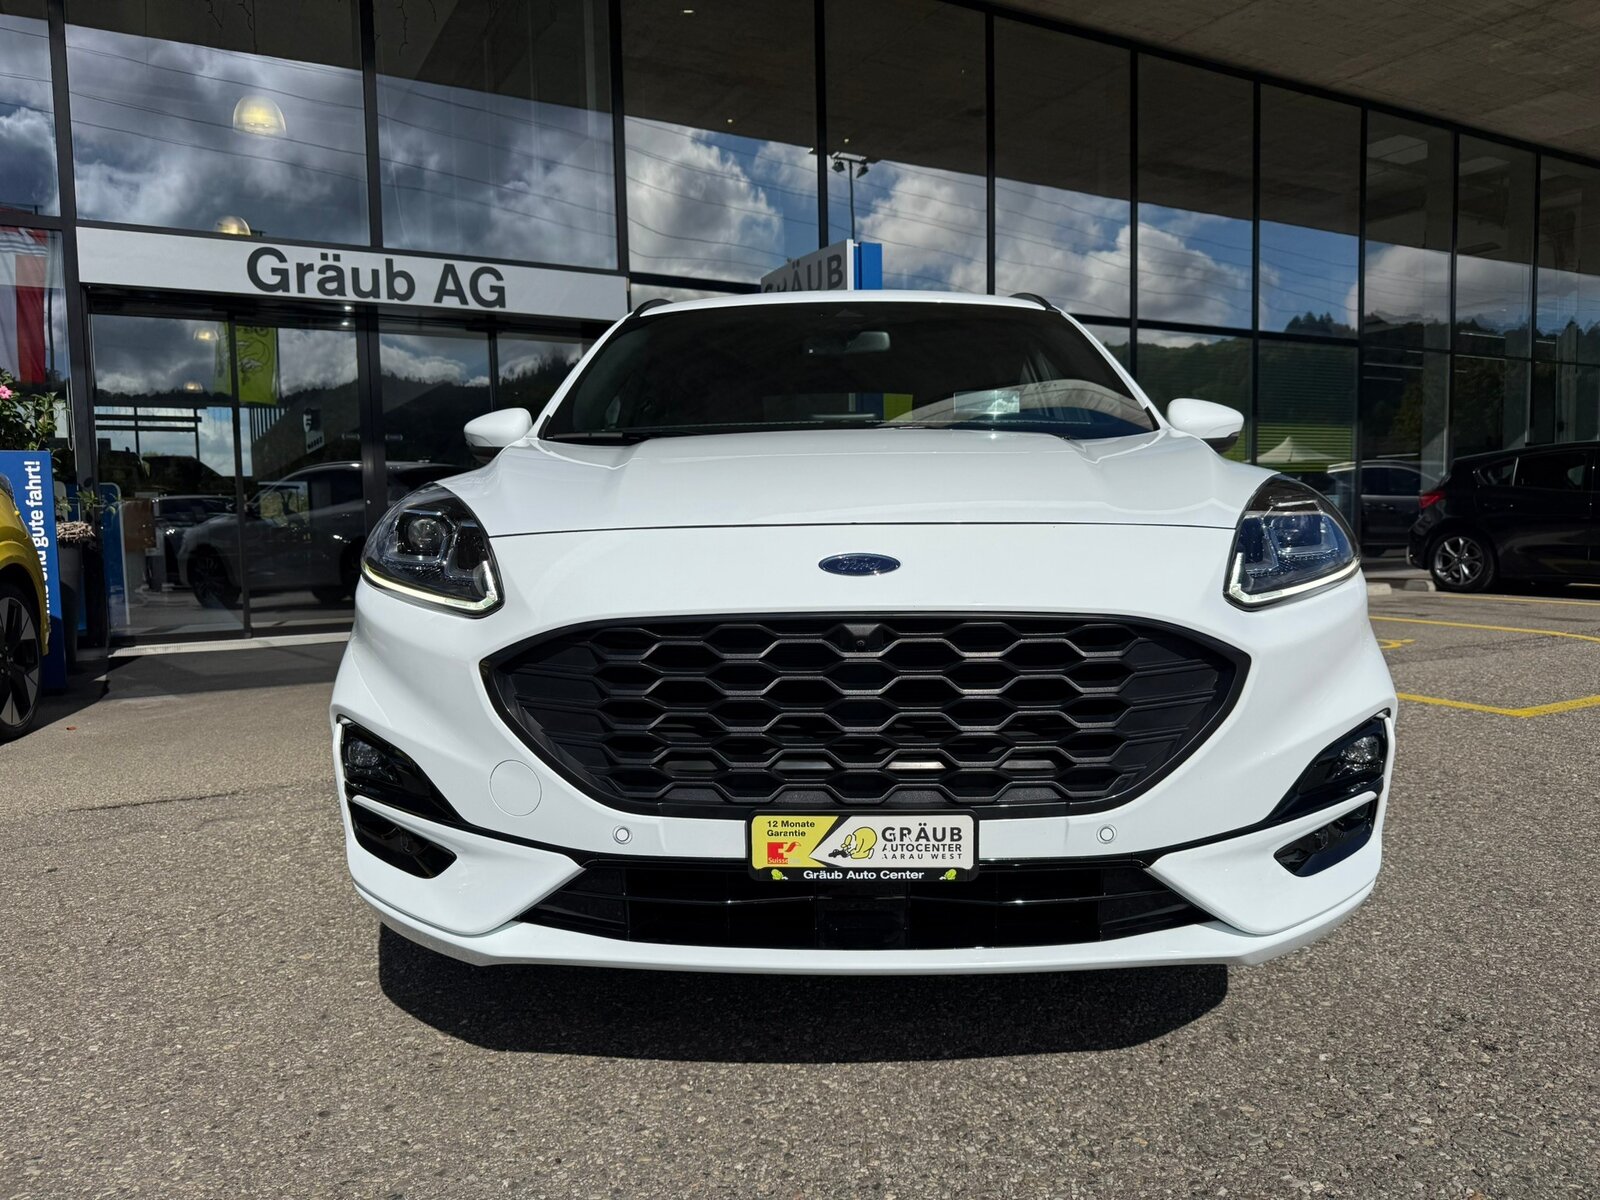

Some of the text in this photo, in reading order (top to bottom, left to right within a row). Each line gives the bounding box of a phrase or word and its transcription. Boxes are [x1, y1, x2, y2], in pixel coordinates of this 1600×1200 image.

[246, 246, 506, 309] Gräub AG
[24, 460, 43, 508] fahrt!
[29, 510, 49, 548] gute
[767, 820, 816, 828] 12 Monate
[767, 829, 806, 837] Garantie
[881, 822, 963, 843] GRÄUB
[882, 843, 963, 852] AUTOCENTER
[803, 870, 925, 879] Gräub Auto Center
